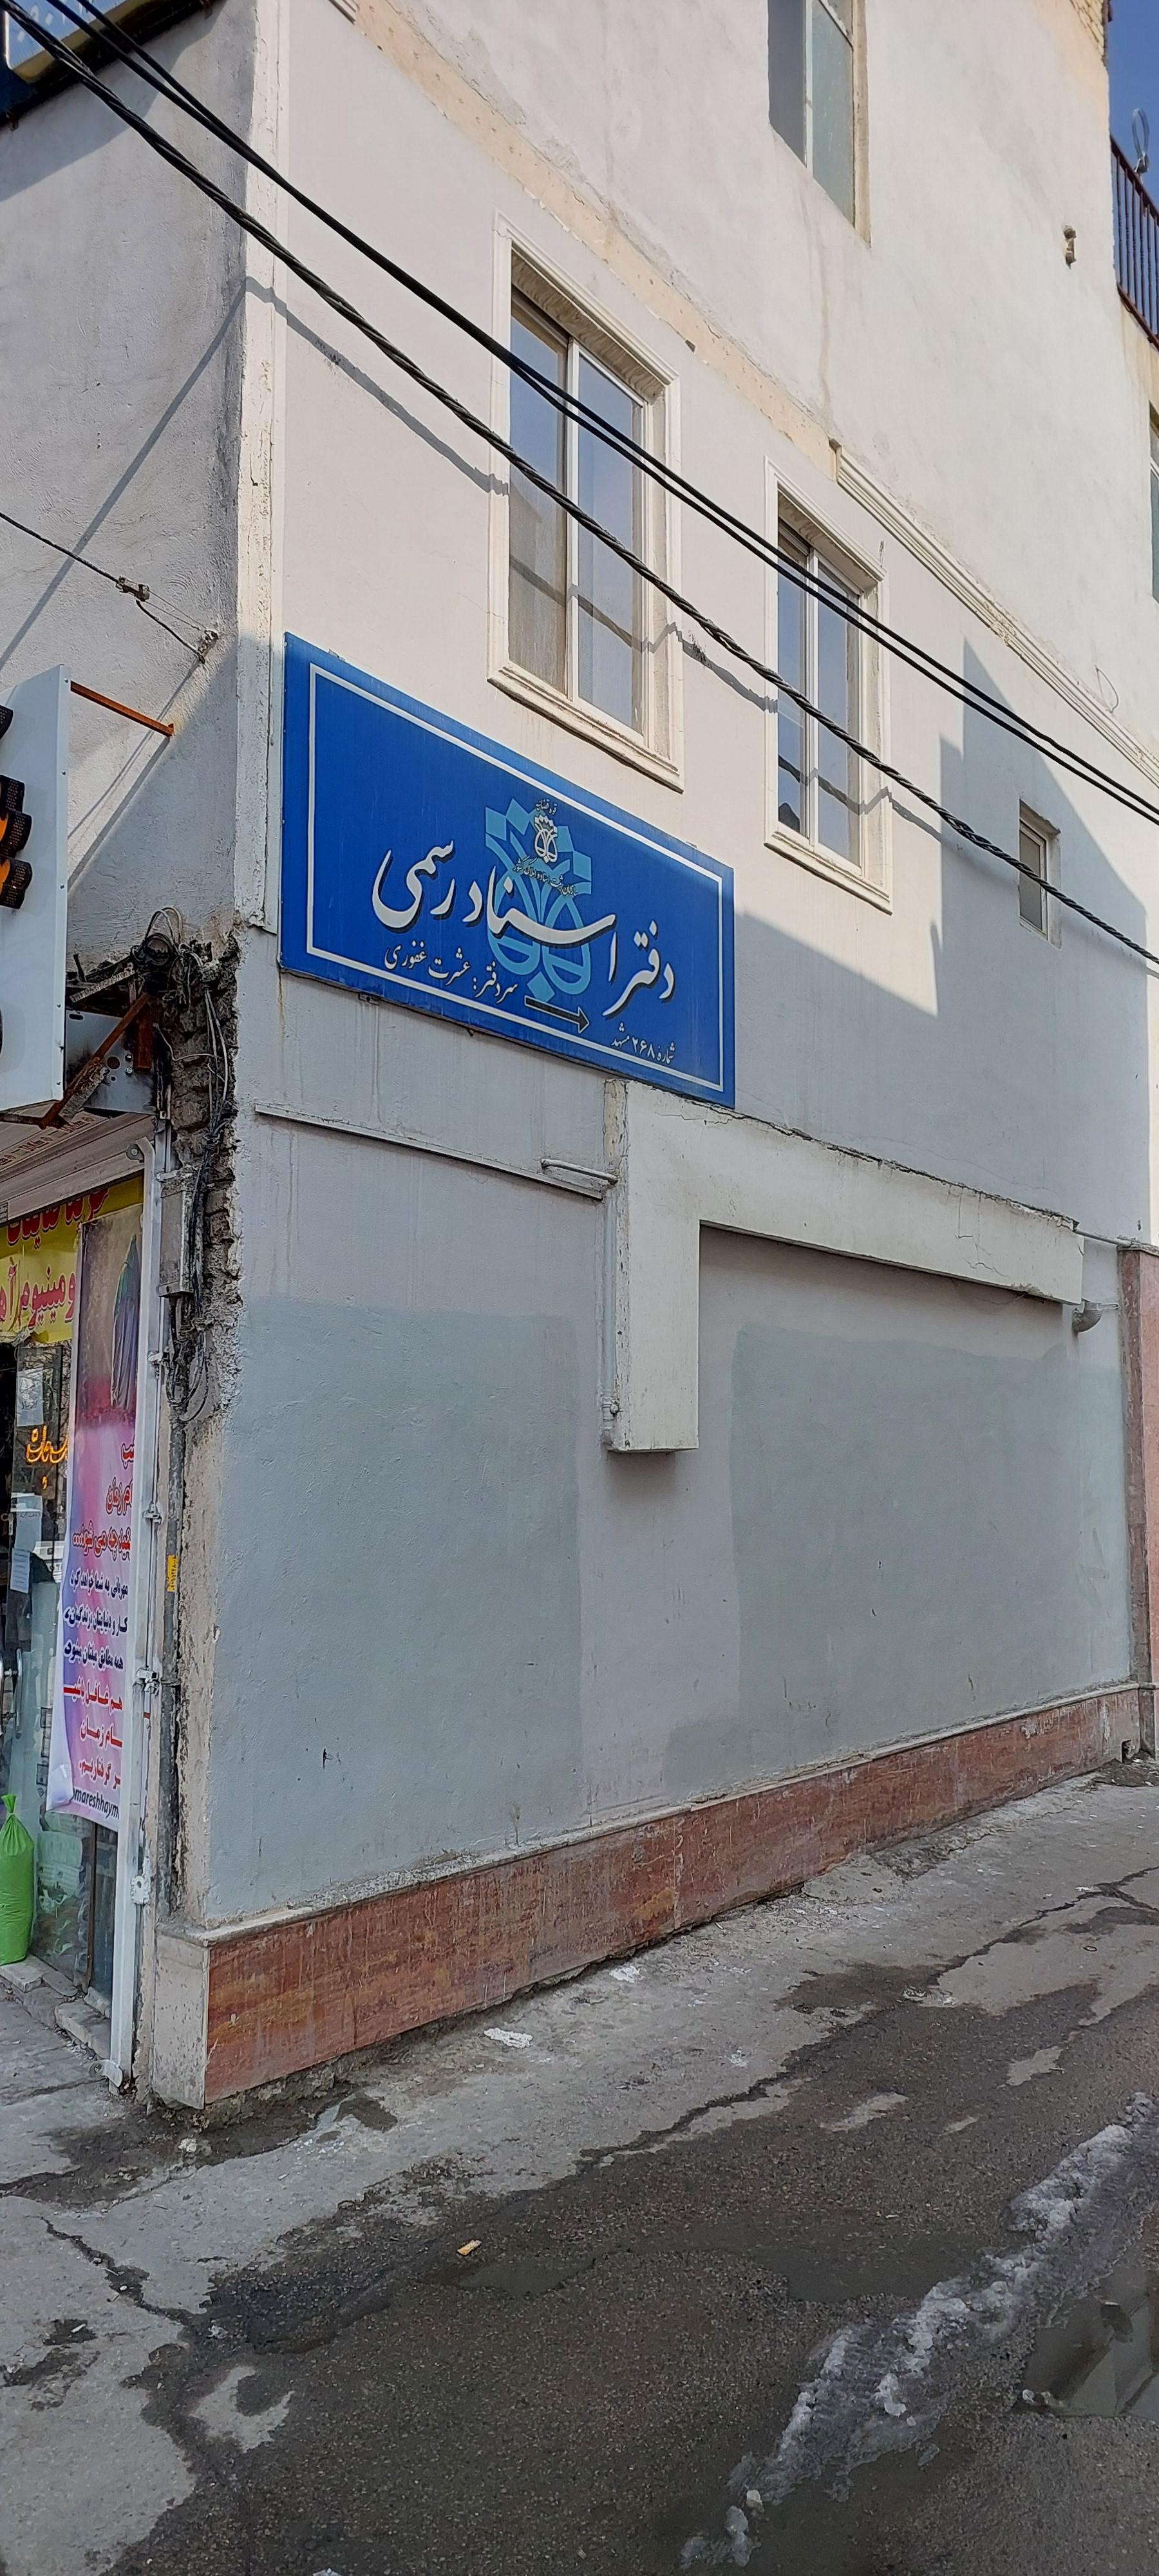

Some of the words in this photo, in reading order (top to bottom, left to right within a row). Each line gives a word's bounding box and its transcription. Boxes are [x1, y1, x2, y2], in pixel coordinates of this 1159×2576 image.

[372, 840, 455, 929] رسمی
[551, 874, 563, 892] ثبت
[561, 884, 578, 896] سازمان
[462, 865, 616, 982] اسناد
[384, 940, 428, 970] غفوری
[428, 947, 471, 987] عشرت
[602, 920, 675, 1016] دفتر
[610, 1021, 630, 1048] مشهد
[632, 1036, 655, 1059] ۲۶۸
[80, 1569, 93, 1594] خواهد
[95, 1571, 104, 1591] شما
[104, 1578, 110, 1596] به
[115, 1614, 128, 1636] کار
[98, 1647, 113, 1671] مطابق
[115, 1654, 124, 1670] همه
[64, 1677, 86, 1703] باشی
[85, 1681, 109, 1705] غافل
[80, 1717, 104, 1747] زمان
